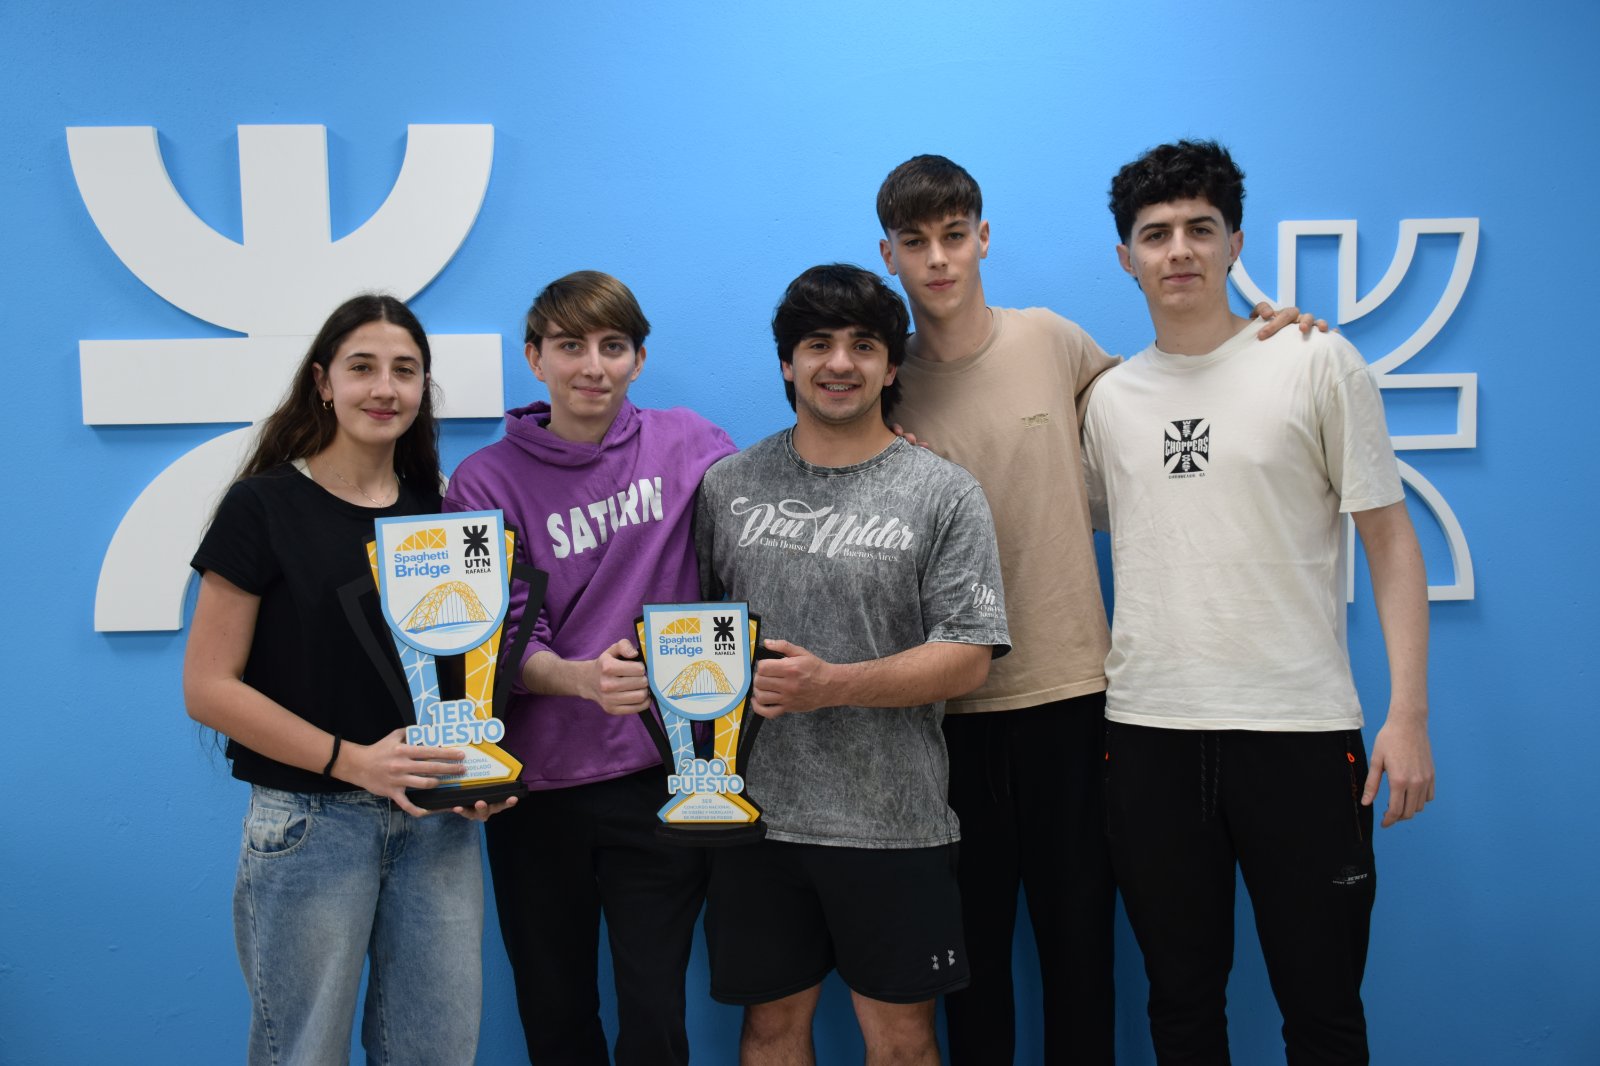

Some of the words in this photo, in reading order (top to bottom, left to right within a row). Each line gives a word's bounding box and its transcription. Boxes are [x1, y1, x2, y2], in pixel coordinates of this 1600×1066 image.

[1165, 436, 1209, 456] CHOPPERS
[731, 497, 805, 547] Den
[759, 536, 777, 549] Club
[779, 539, 808, 552] House
[394, 550, 449, 564] Spaghetti
[464, 558, 491, 568] UTN
[843, 547, 874, 560] Buenos
[875, 551, 898, 563] Aires
[395, 562, 451, 578] Bridge
[659, 635, 702, 645] Spaghetti
[714, 643, 736, 651] UTN
[659, 645, 703, 657] Bridge
[428, 700, 475, 725] 1ER
[408, 720, 503, 746] PUESTO
[681, 760, 725, 776] 2DO
[669, 776, 744, 793] PUESTO
